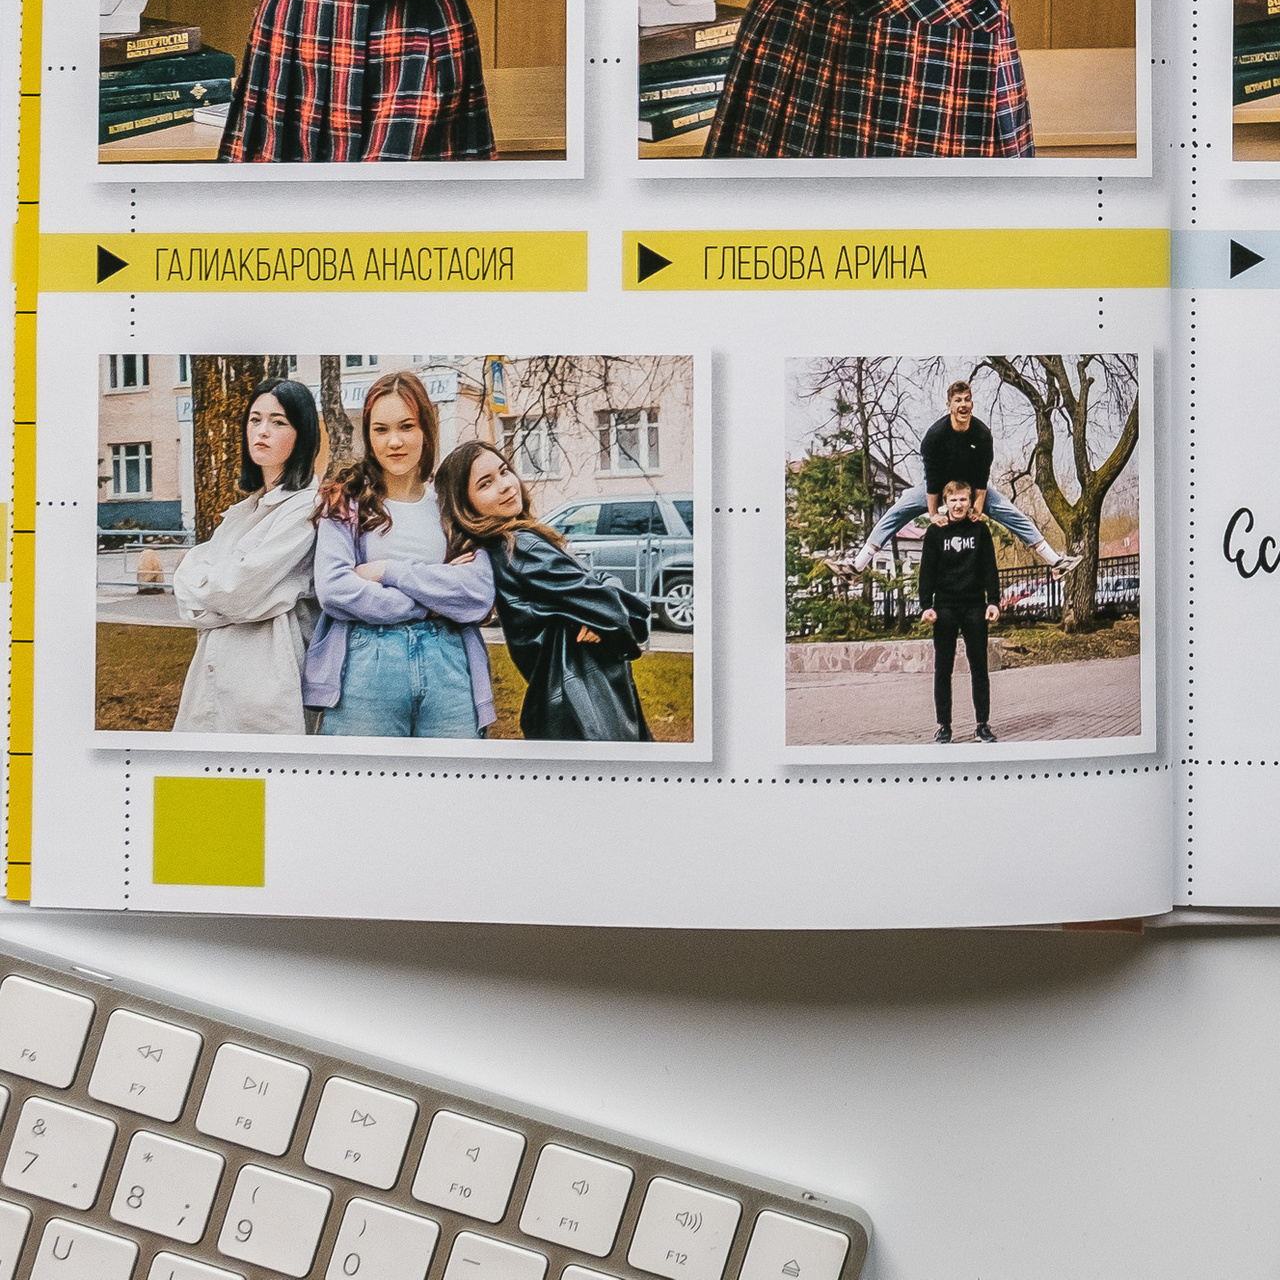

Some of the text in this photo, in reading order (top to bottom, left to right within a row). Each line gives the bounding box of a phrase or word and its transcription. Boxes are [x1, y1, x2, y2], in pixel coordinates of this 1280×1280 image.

[156, 246, 514, 281] ГАЛИАКБАРОВА АНАСТАСИЯ
[704, 245, 927, 280] ГЛЕБОВА АРИНА
[21, 1047, 37, 1062] F6
[129, 1081, 146, 1097] F7
[235, 1115, 252, 1131] F8
[20, 1151, 39, 1174] 7
[344, 1149, 362, 1164] F9
[126, 1185, 145, 1210] 8
[450, 1183, 472, 1199] F10
[235, 1219, 253, 1243] 9
[558, 1217, 580, 1233] F11
[53, 1235, 74, 1260] U
[665, 1249, 689, 1266] F12
